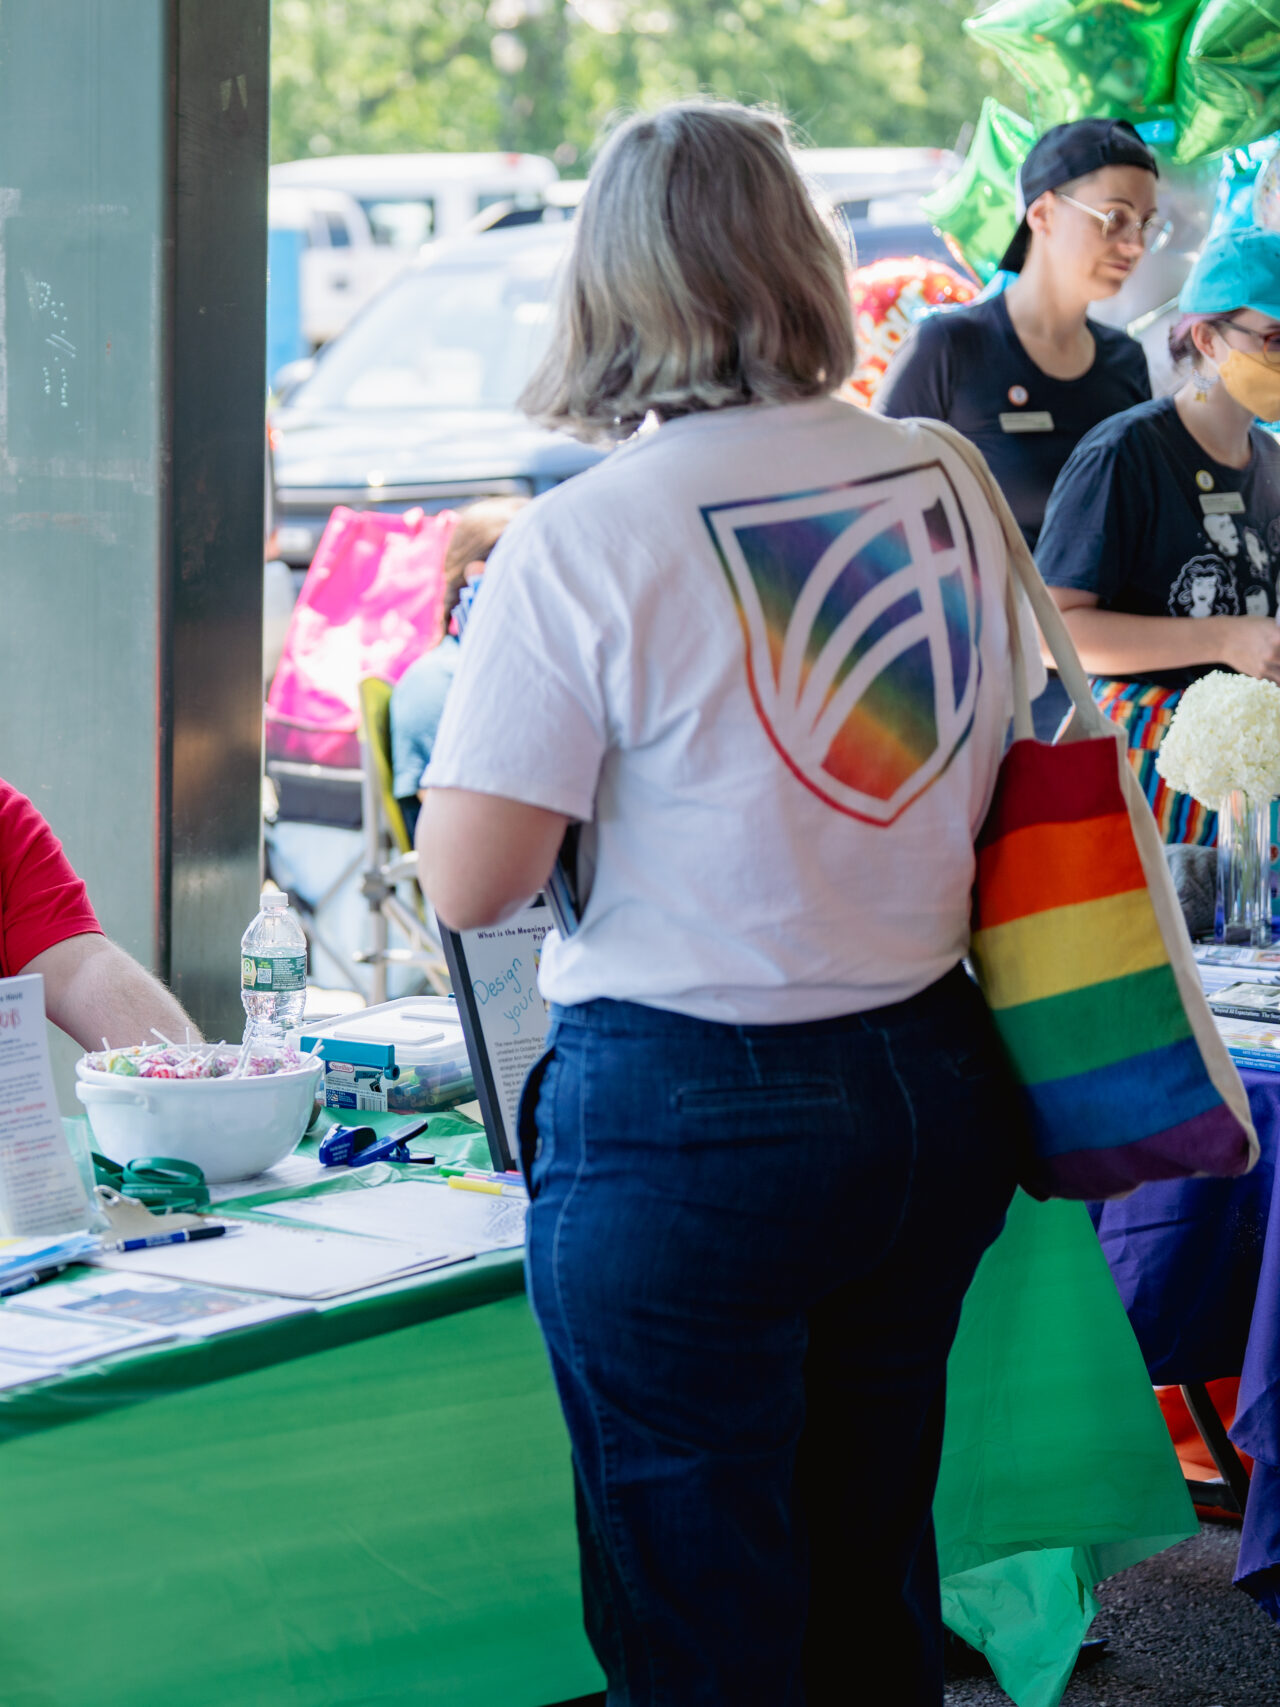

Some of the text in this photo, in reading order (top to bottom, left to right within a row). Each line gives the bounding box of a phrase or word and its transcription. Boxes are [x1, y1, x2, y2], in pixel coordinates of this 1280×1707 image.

[477, 930, 496, 940] What
[504, 927, 516, 936] the
[517, 923, 546, 936] Meaning
[472, 957, 523, 1005] Design
[502, 986, 535, 1036] your
